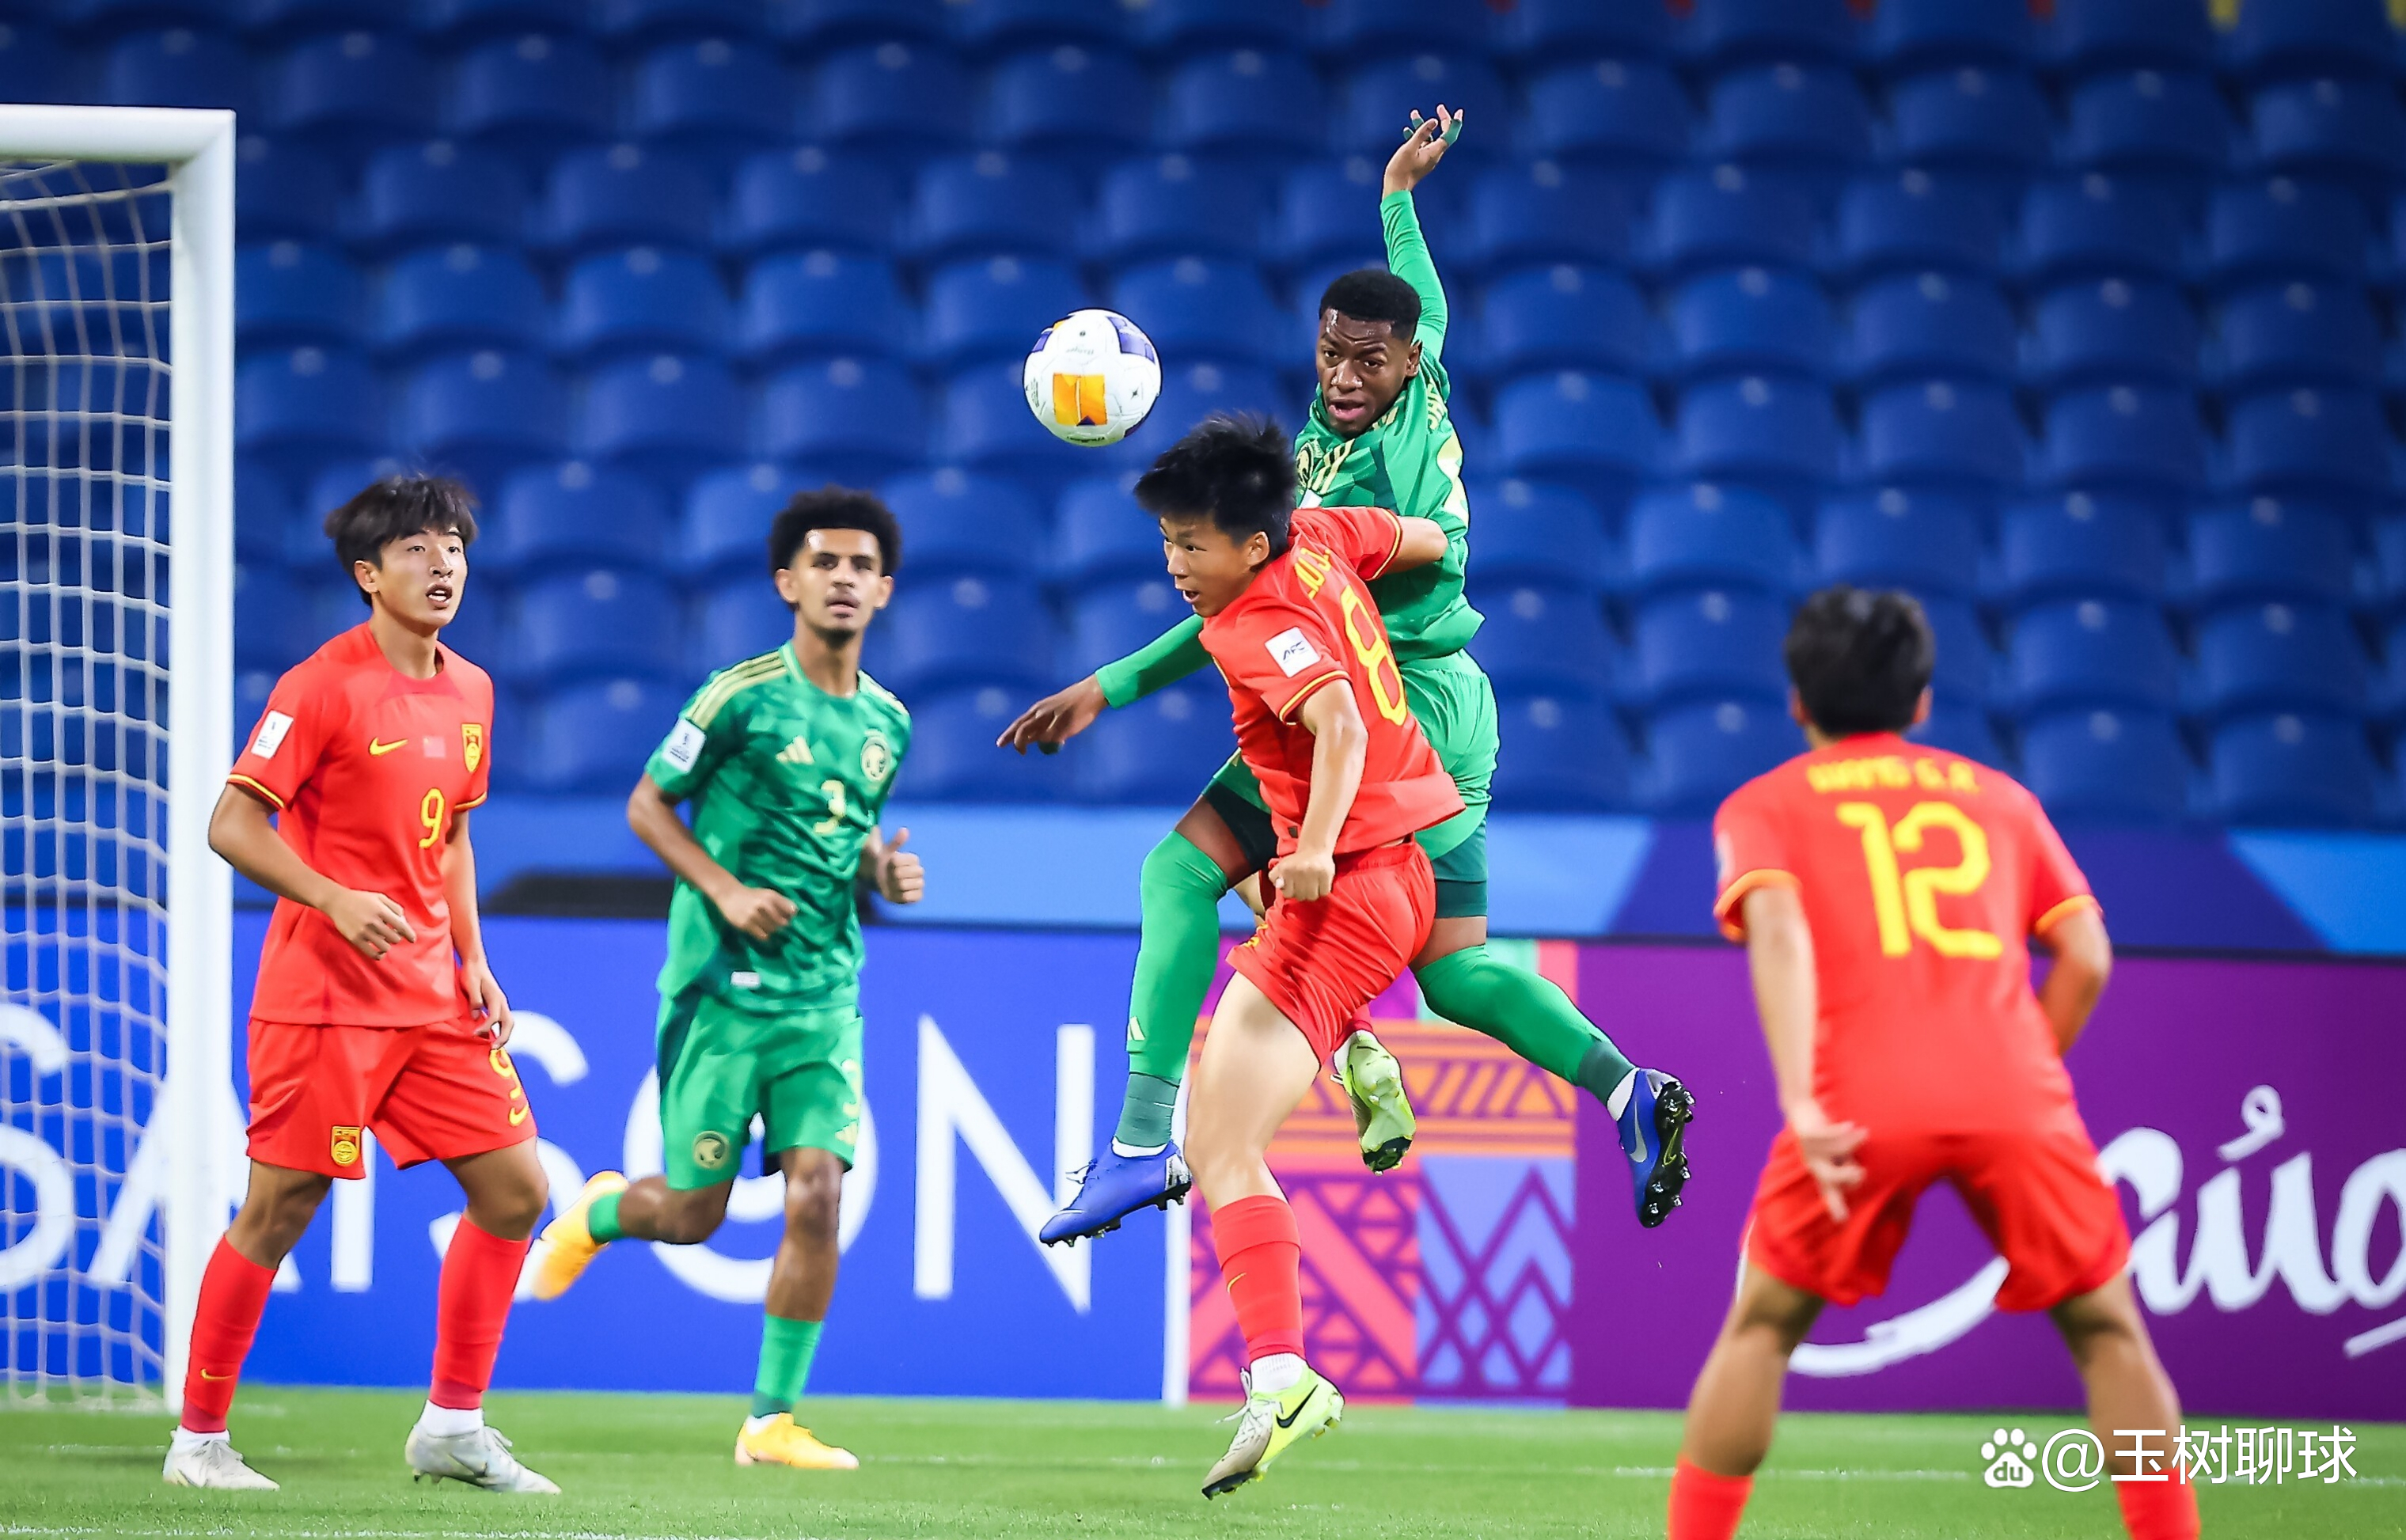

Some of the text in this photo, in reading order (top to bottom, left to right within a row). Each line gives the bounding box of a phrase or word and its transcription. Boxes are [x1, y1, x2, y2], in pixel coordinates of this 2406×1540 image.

[1283, 640, 1306, 660] AFC
[1342, 585, 1407, 725] 8
[419, 788, 445, 848] 9
[814, 779, 845, 833] 3
[1836, 802, 2003, 958] 12
[488, 1047, 521, 1100] 9
